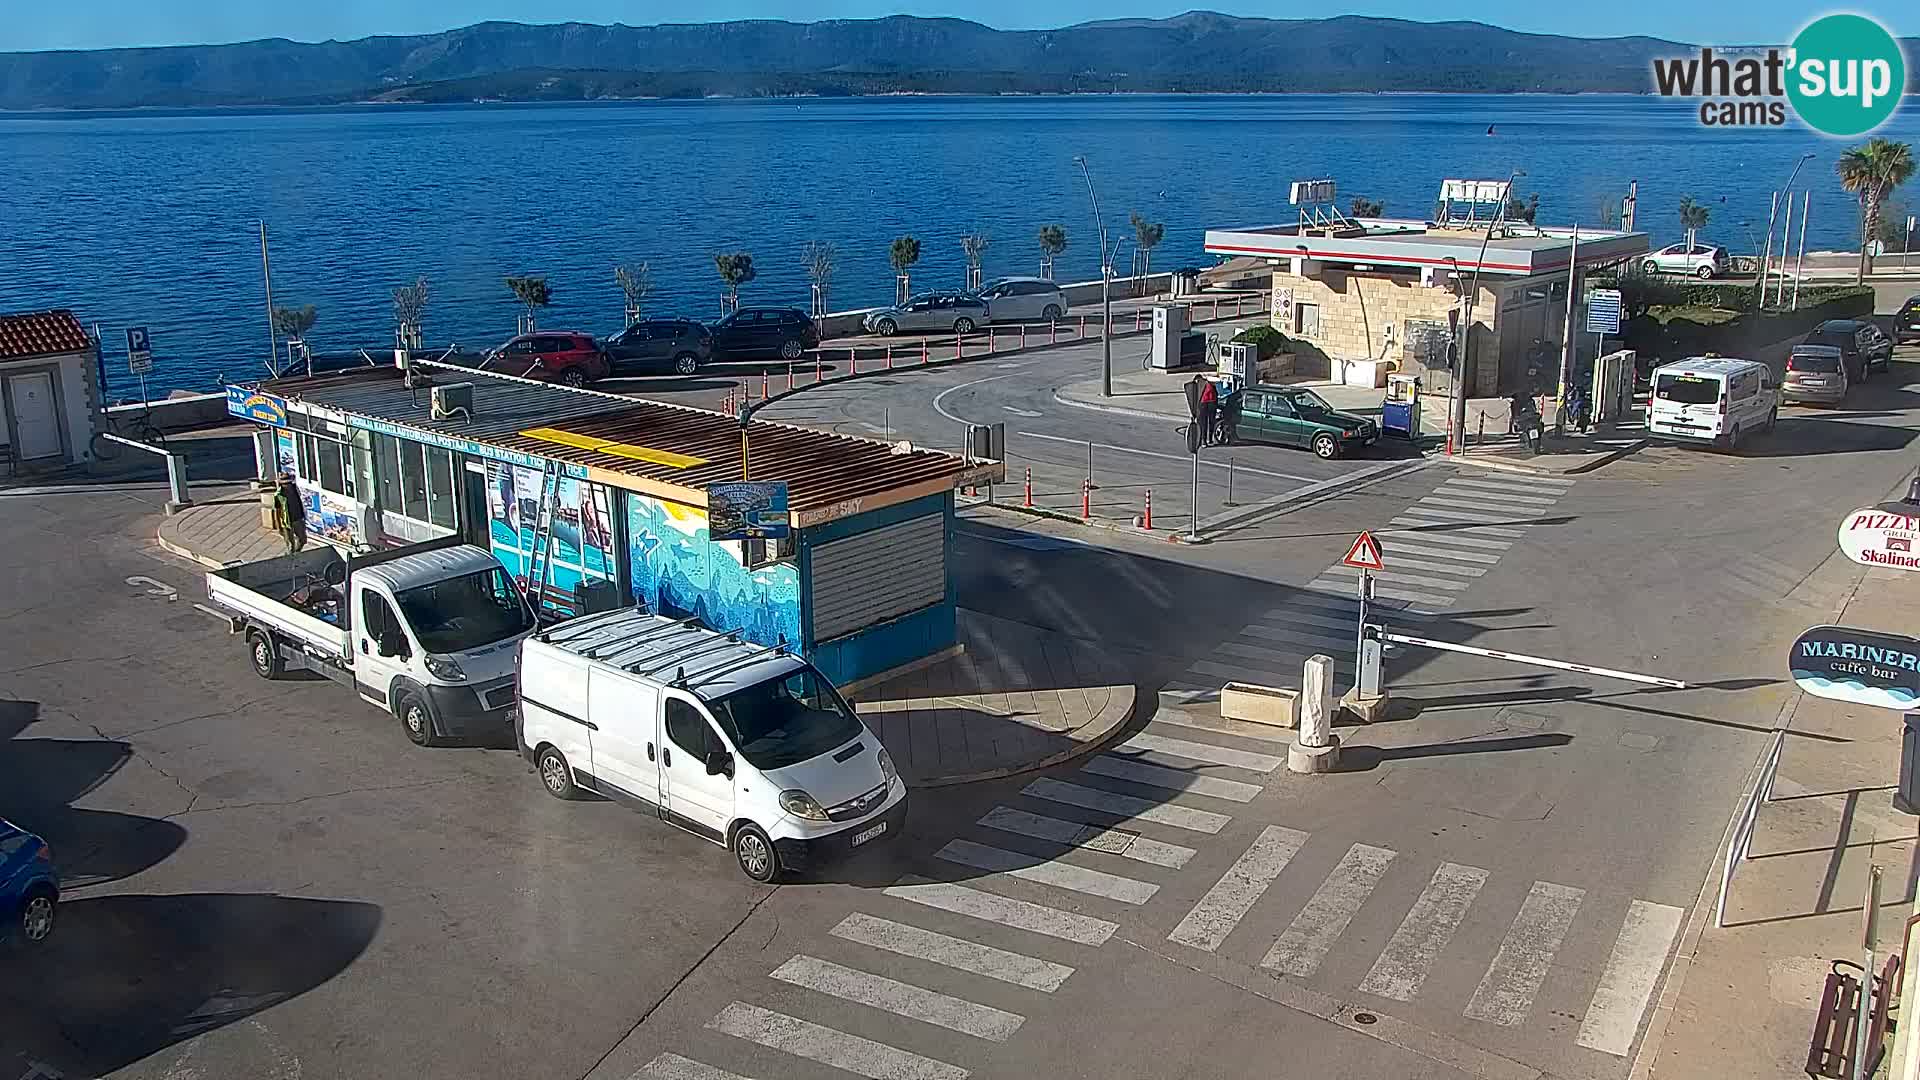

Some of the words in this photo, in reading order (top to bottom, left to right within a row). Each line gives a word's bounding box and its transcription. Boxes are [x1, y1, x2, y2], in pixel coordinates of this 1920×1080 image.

[131, 330, 144, 349] P
[480, 443, 494, 457] BUS
[494, 446, 527, 465] STATION
[1883, 530, 1918, 539] GRILL
[1801, 641, 1920, 673] MARINER
[1830, 662, 1867, 674] caffe
[1871, 666, 1899, 680] bar
